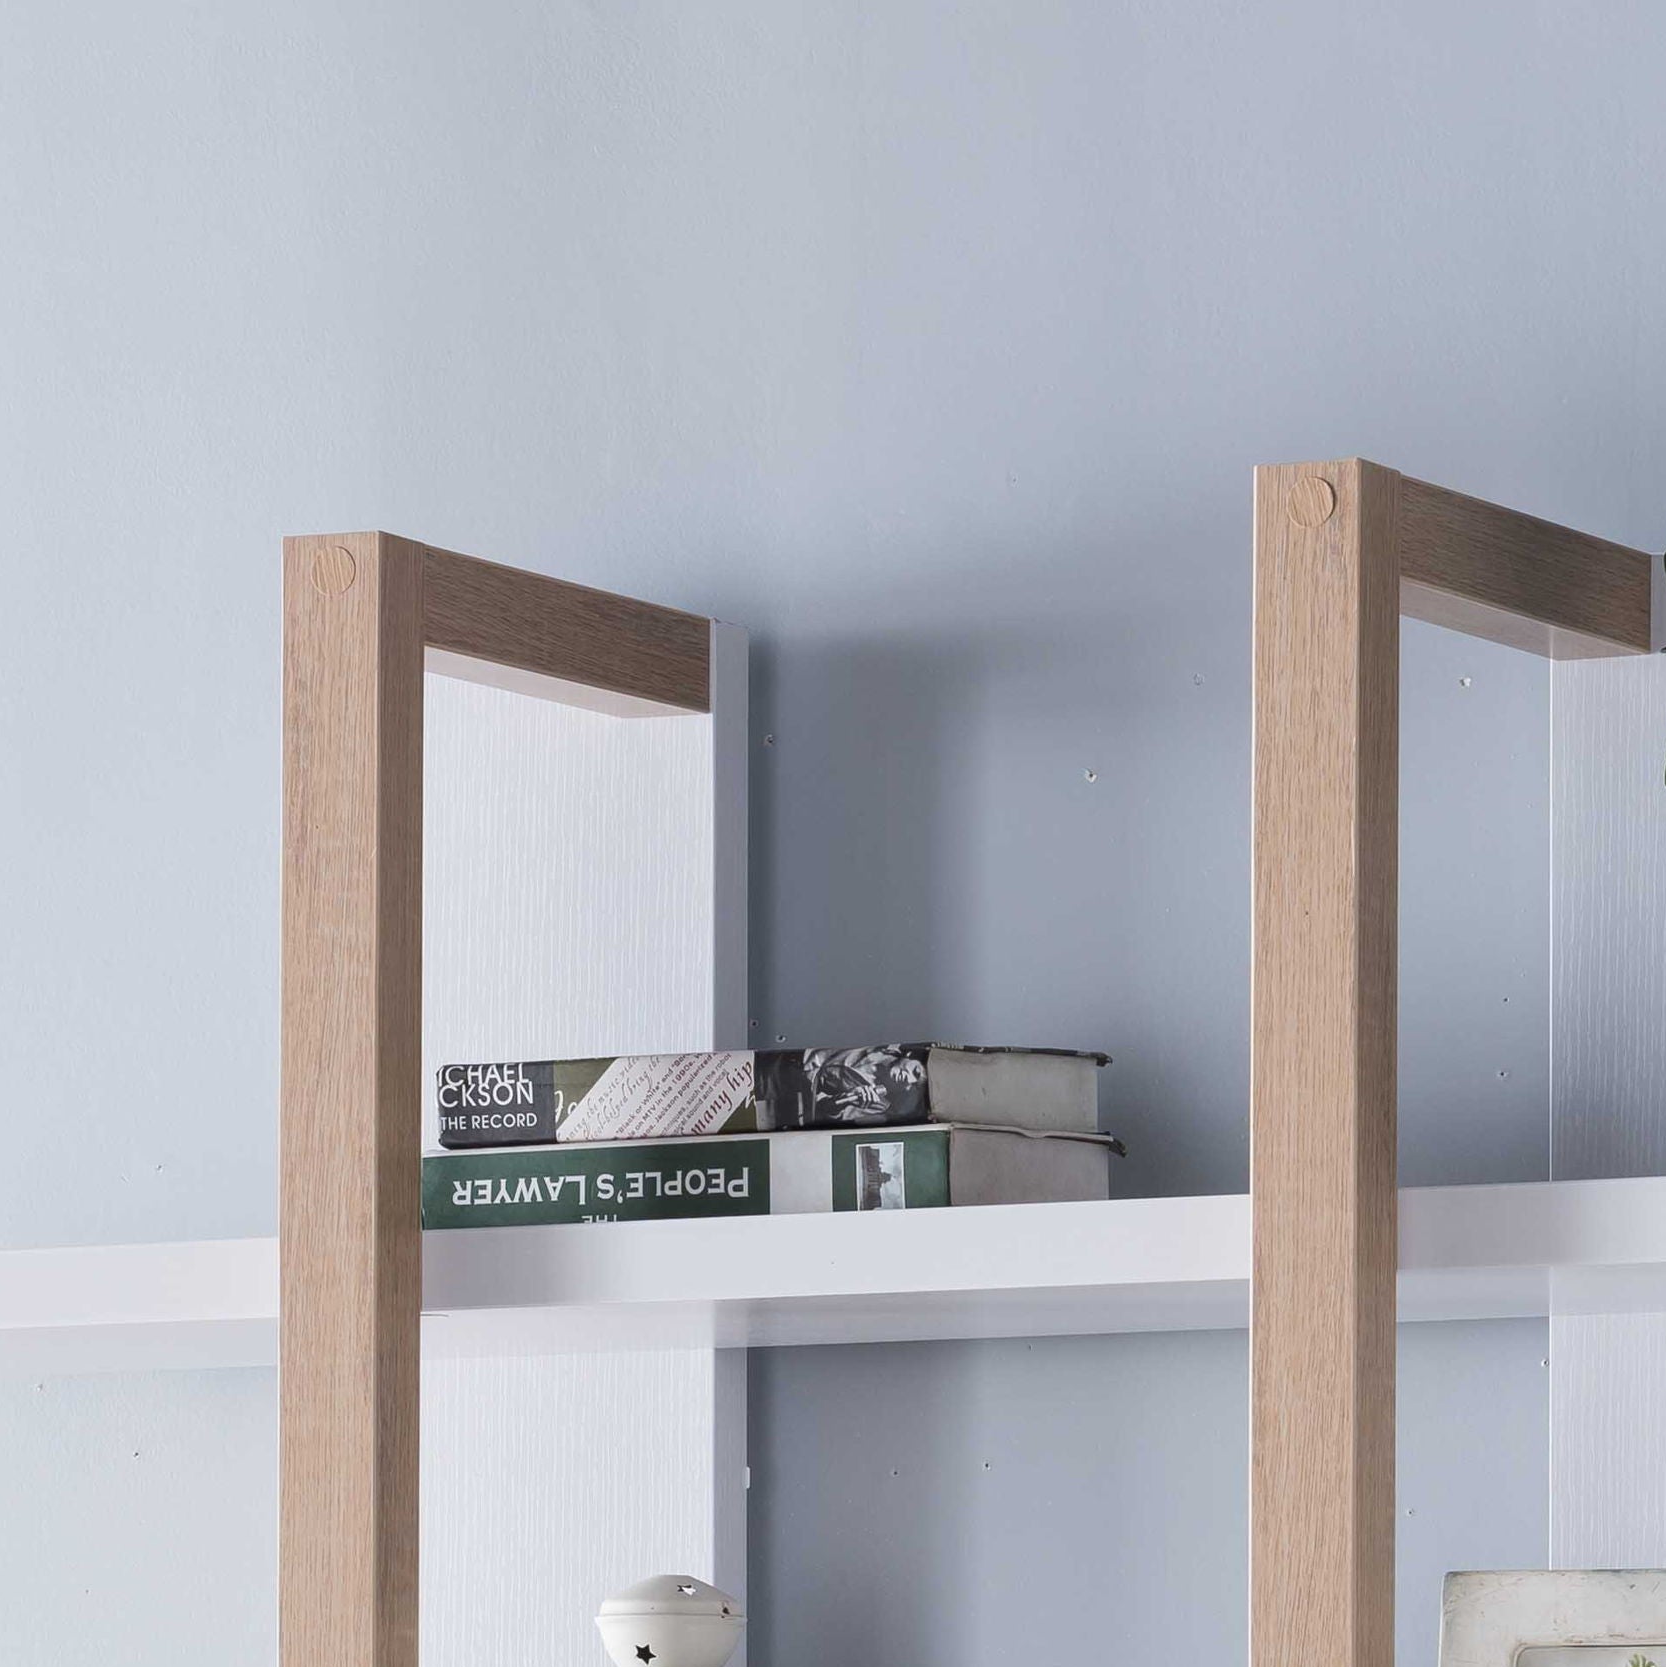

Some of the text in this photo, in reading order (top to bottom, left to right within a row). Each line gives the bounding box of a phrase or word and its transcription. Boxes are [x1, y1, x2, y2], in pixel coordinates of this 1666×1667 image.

[439, 1081, 533, 1108] CKSON
[691, 1060, 753, 1135] many hip
[440, 1113, 537, 1130] THE RECORD
[451, 1167, 751, 1206] PEOPLE'S LAWYER
